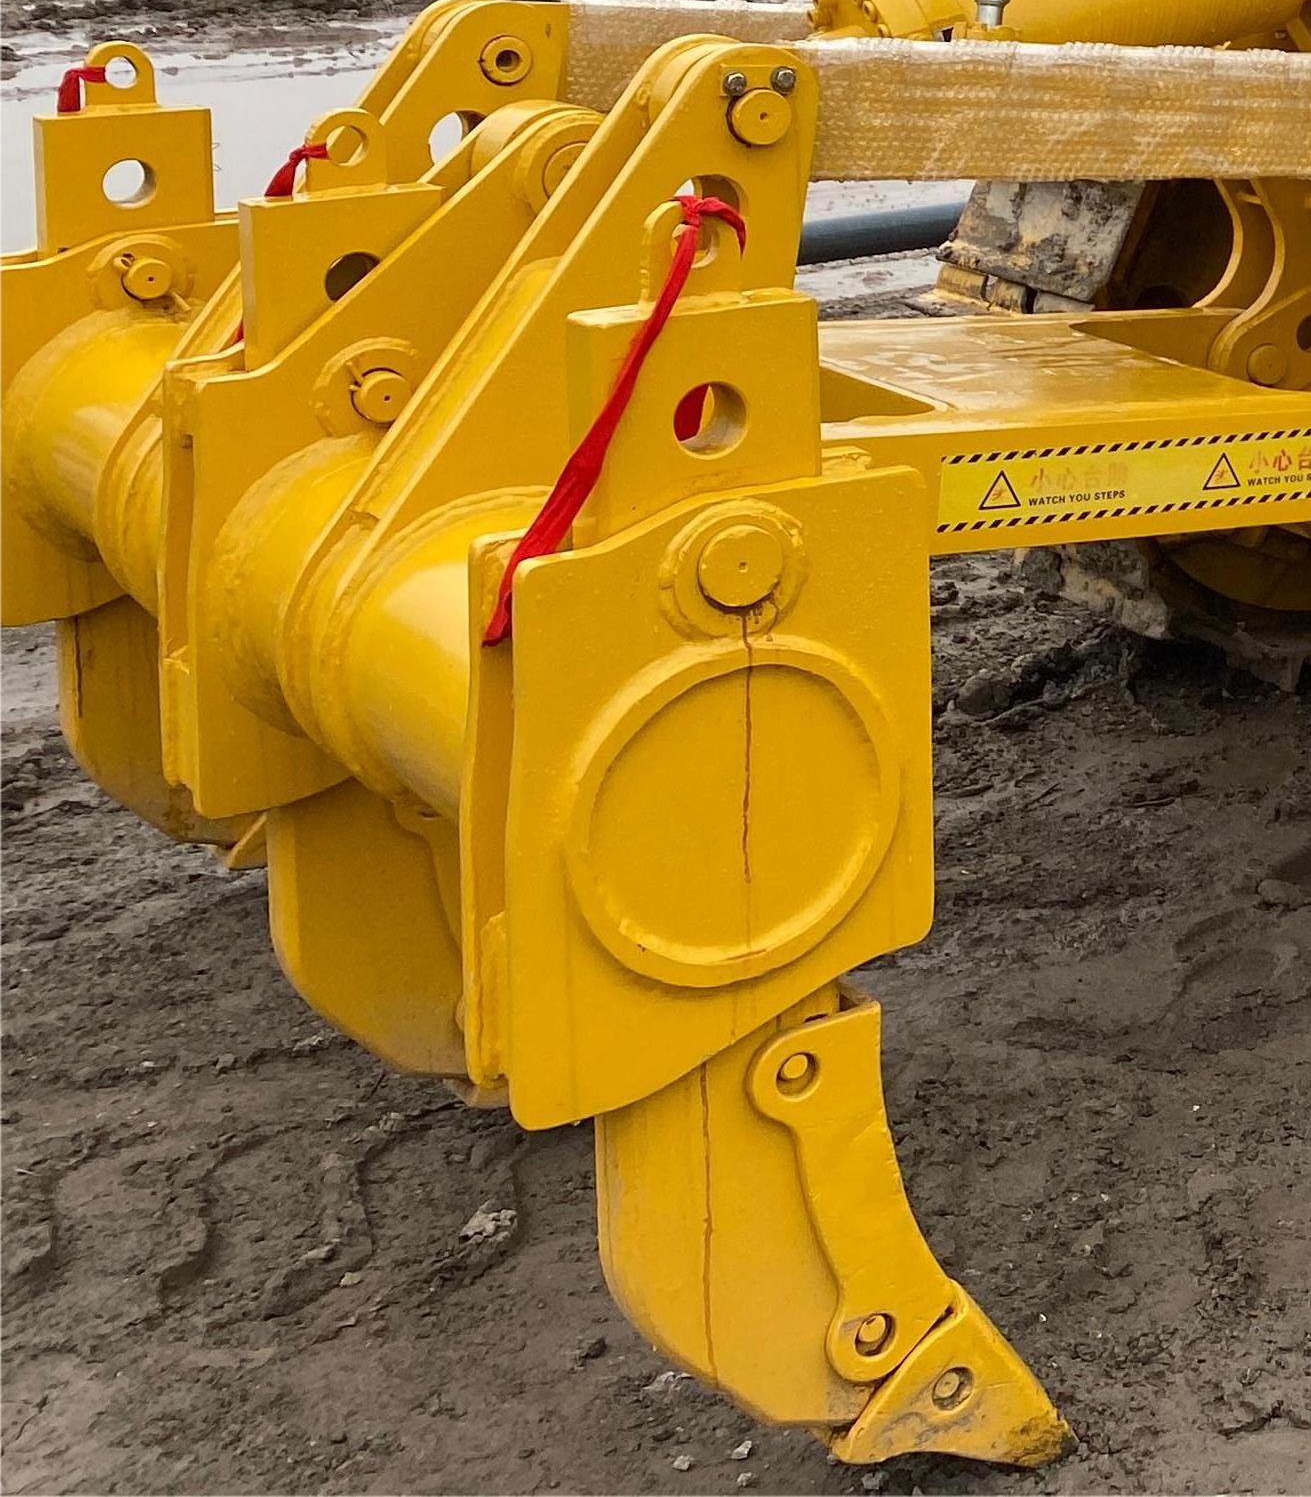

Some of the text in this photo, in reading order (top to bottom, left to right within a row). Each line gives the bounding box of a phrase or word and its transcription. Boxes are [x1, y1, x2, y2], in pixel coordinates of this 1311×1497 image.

[1247, 476, 1281, 487] WATCH
[1284, 473, 1304, 484] YOU
[1028, 489, 1126, 507] WATCH YOU STEPS
